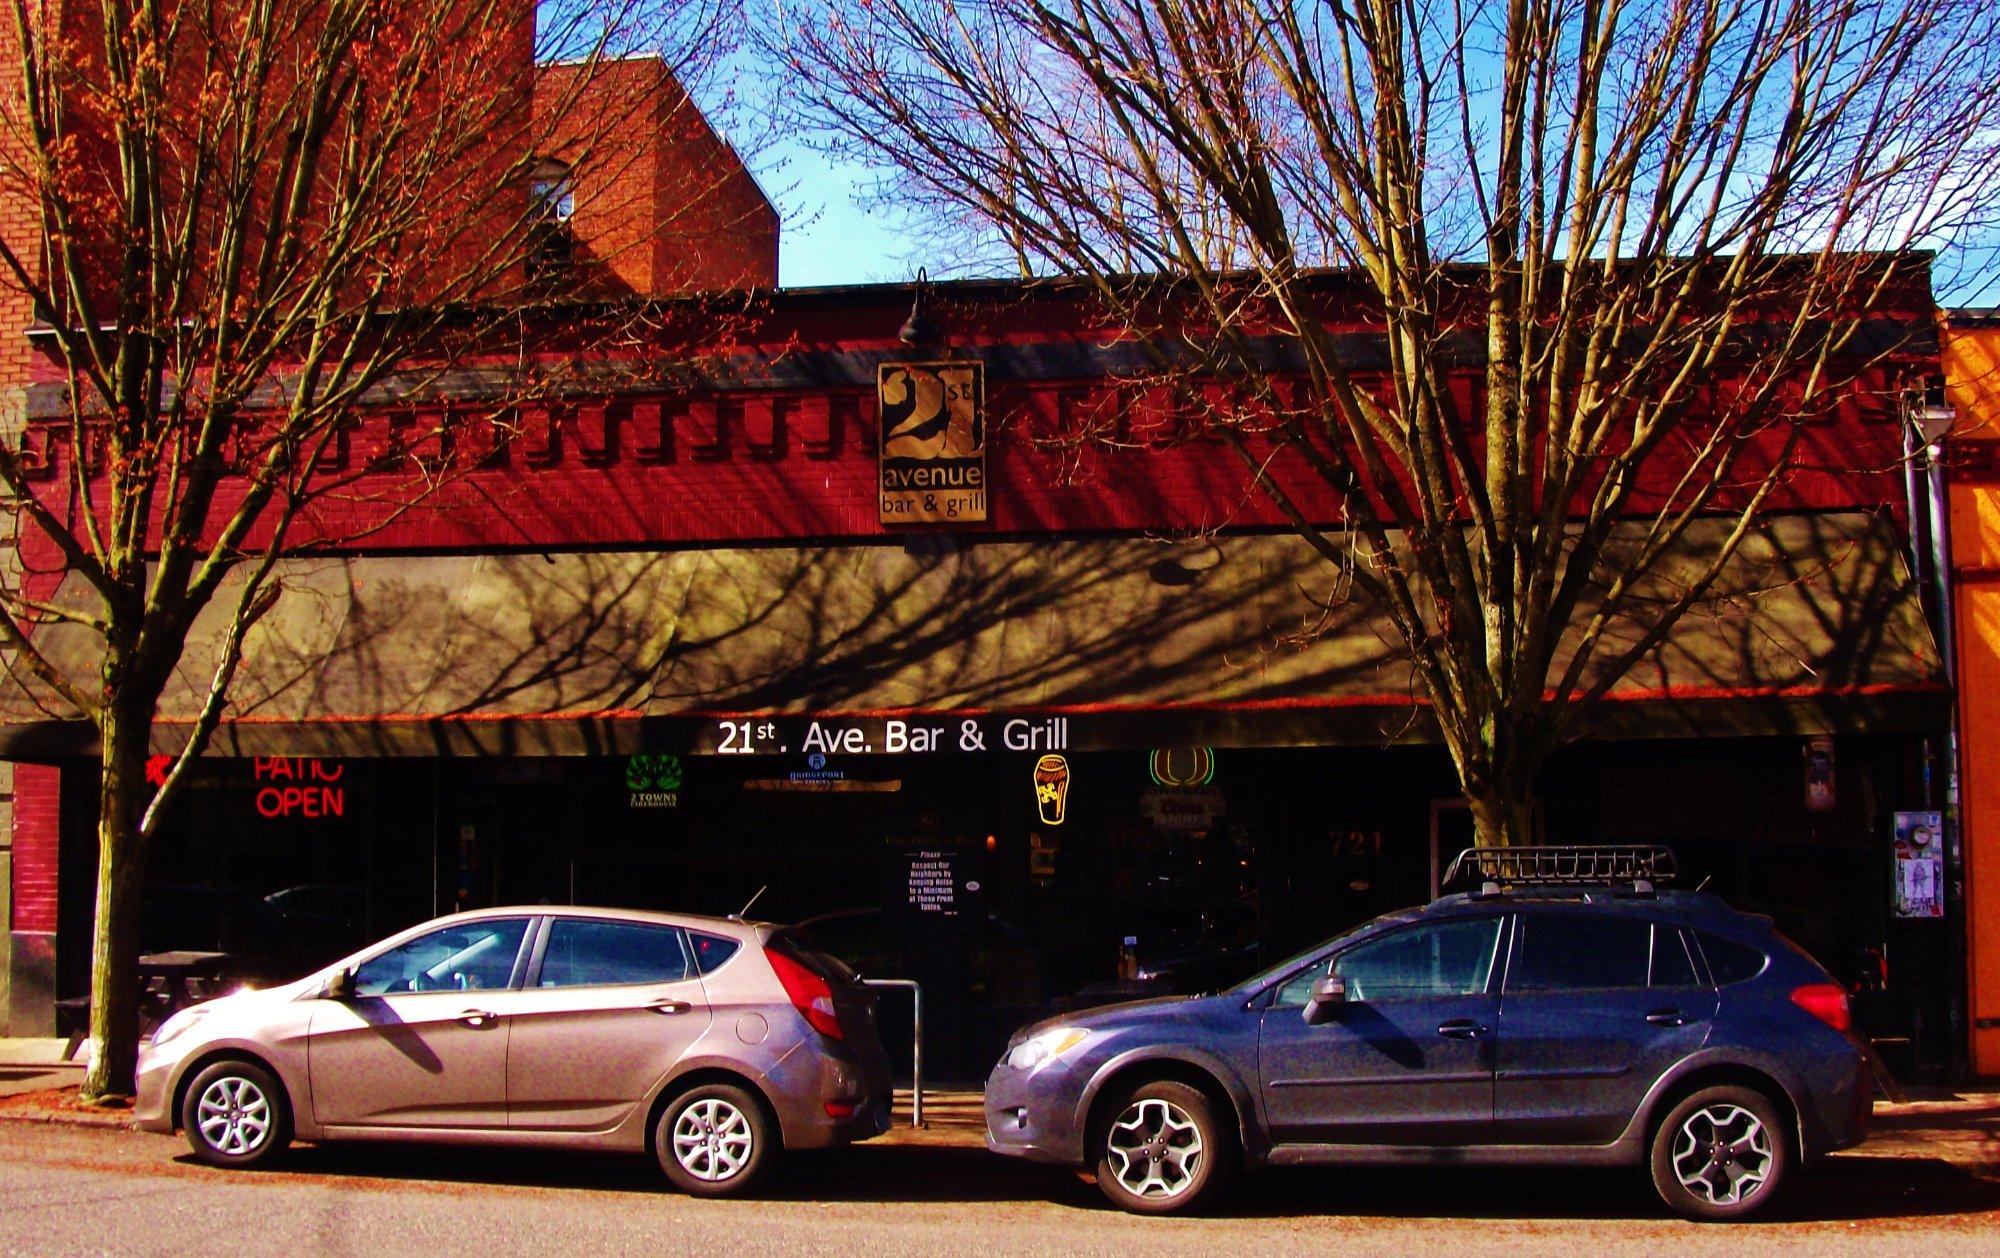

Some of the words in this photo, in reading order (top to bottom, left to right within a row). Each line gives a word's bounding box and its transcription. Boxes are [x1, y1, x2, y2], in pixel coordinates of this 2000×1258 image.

[884, 465, 982, 488] avenue
[882, 494, 915, 513] bar
[923, 493, 939, 513] &
[946, 490, 985, 517] grill
[801, 721, 873, 753] Ave.
[886, 720, 945, 752] Bar
[958, 719, 988, 751] &
[1003, 717, 1069, 751] Grill
[254, 786, 345, 820] OPEN
[1328, 830, 1384, 858] 721
